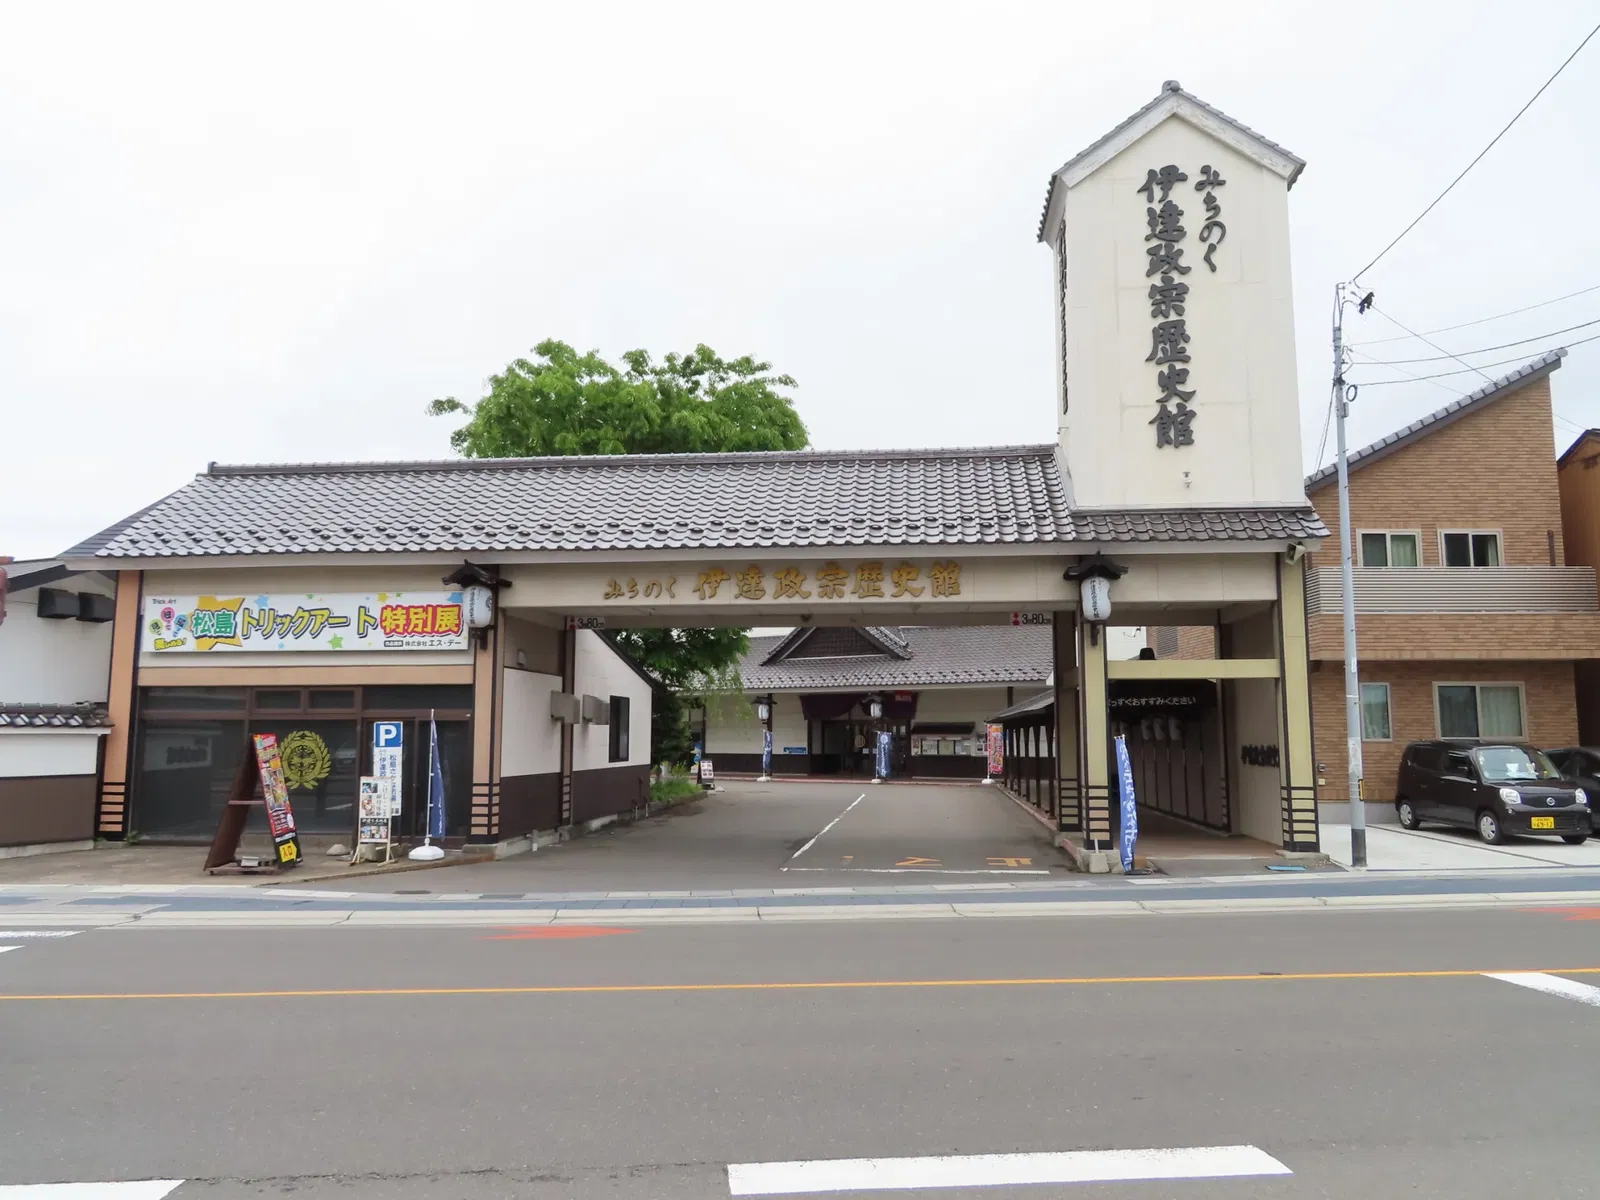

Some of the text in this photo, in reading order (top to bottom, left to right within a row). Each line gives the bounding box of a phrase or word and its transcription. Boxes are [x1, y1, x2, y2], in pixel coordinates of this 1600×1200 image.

[1194, 164, 1227, 272] みちのく
[1137, 164, 1197, 449] 伊達政宗歴史館
[603, 560, 962, 600] みちのく 伊達政宗歴史館
[379, 724, 397, 747] P
